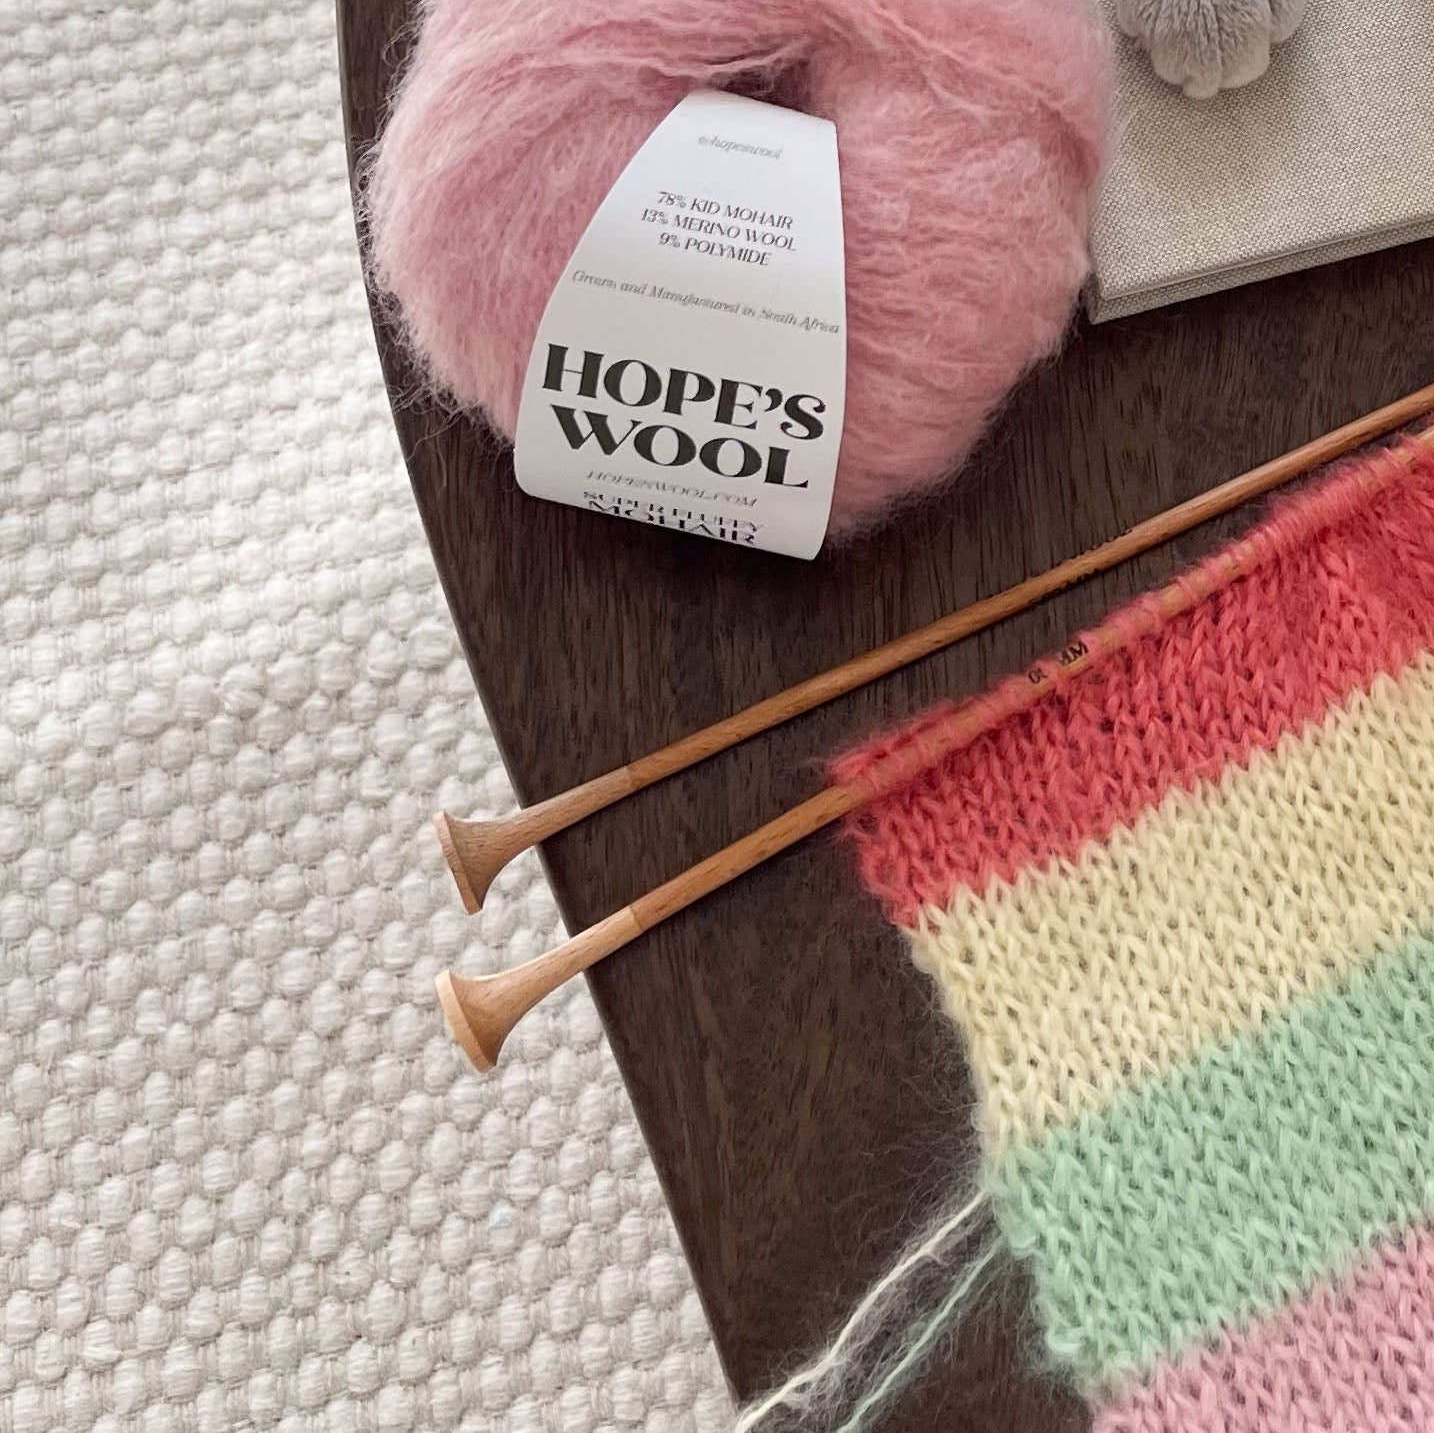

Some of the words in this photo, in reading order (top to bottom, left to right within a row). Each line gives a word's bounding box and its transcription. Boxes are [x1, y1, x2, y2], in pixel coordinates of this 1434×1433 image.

[641, 208, 669, 225] 13%
[674, 214, 741, 239] MERINO
[743, 227, 799, 252] WOOL
[657, 190, 687, 209] 78%
[689, 197, 721, 215] KID
[723, 204, 794, 230] MOHAIR
[659, 232, 681, 248] 9%
[684, 236, 772, 267] POLYMIDE
[541, 342, 826, 441] HOPE'S
[549, 403, 809, 489] WOOL
